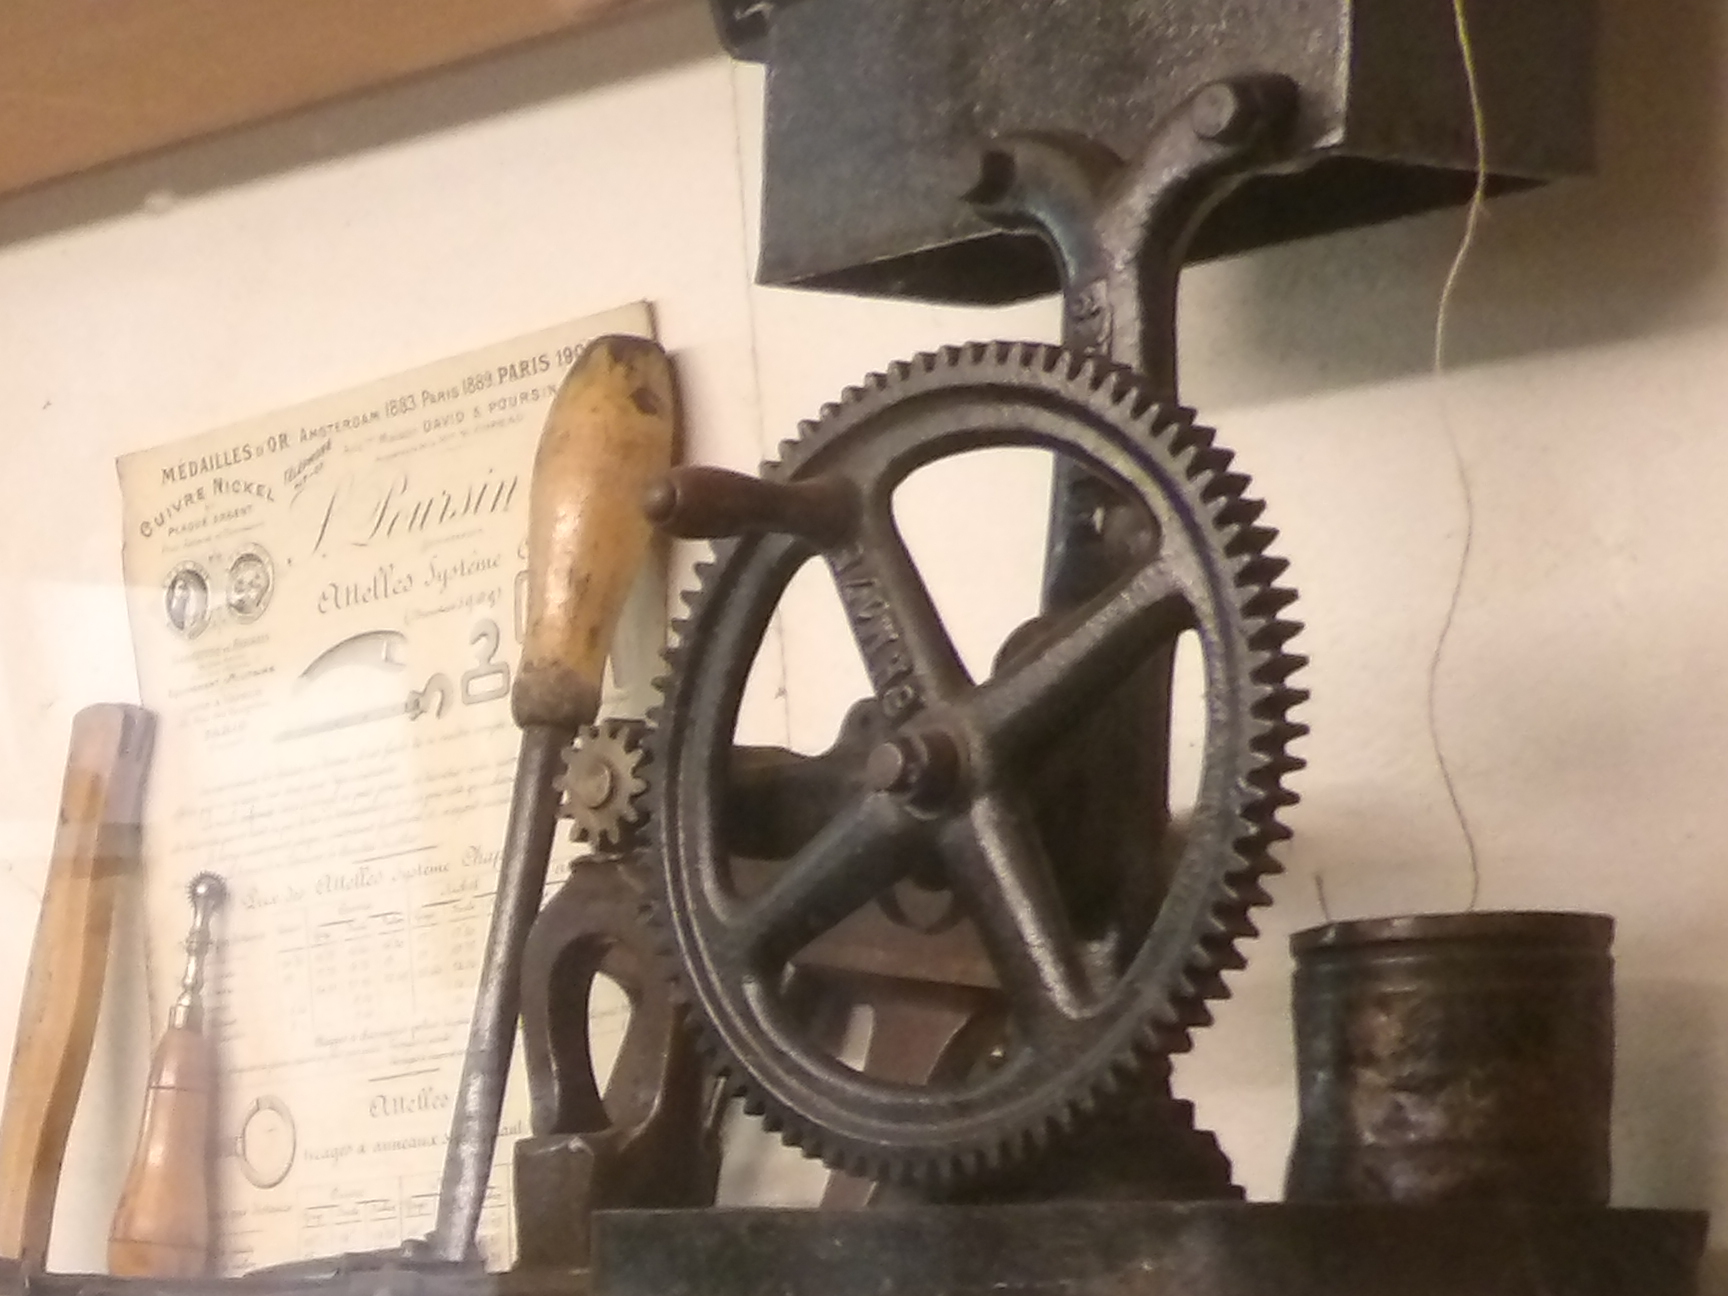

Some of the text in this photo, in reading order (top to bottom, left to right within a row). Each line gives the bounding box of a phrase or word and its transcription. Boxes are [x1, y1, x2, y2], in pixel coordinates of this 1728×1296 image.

[160, 443, 253, 486] MÉDAILLES
[497, 352, 551, 386] PARIS
[555, 342, 588, 368] 190
[213, 476, 276, 503] NICKEL
